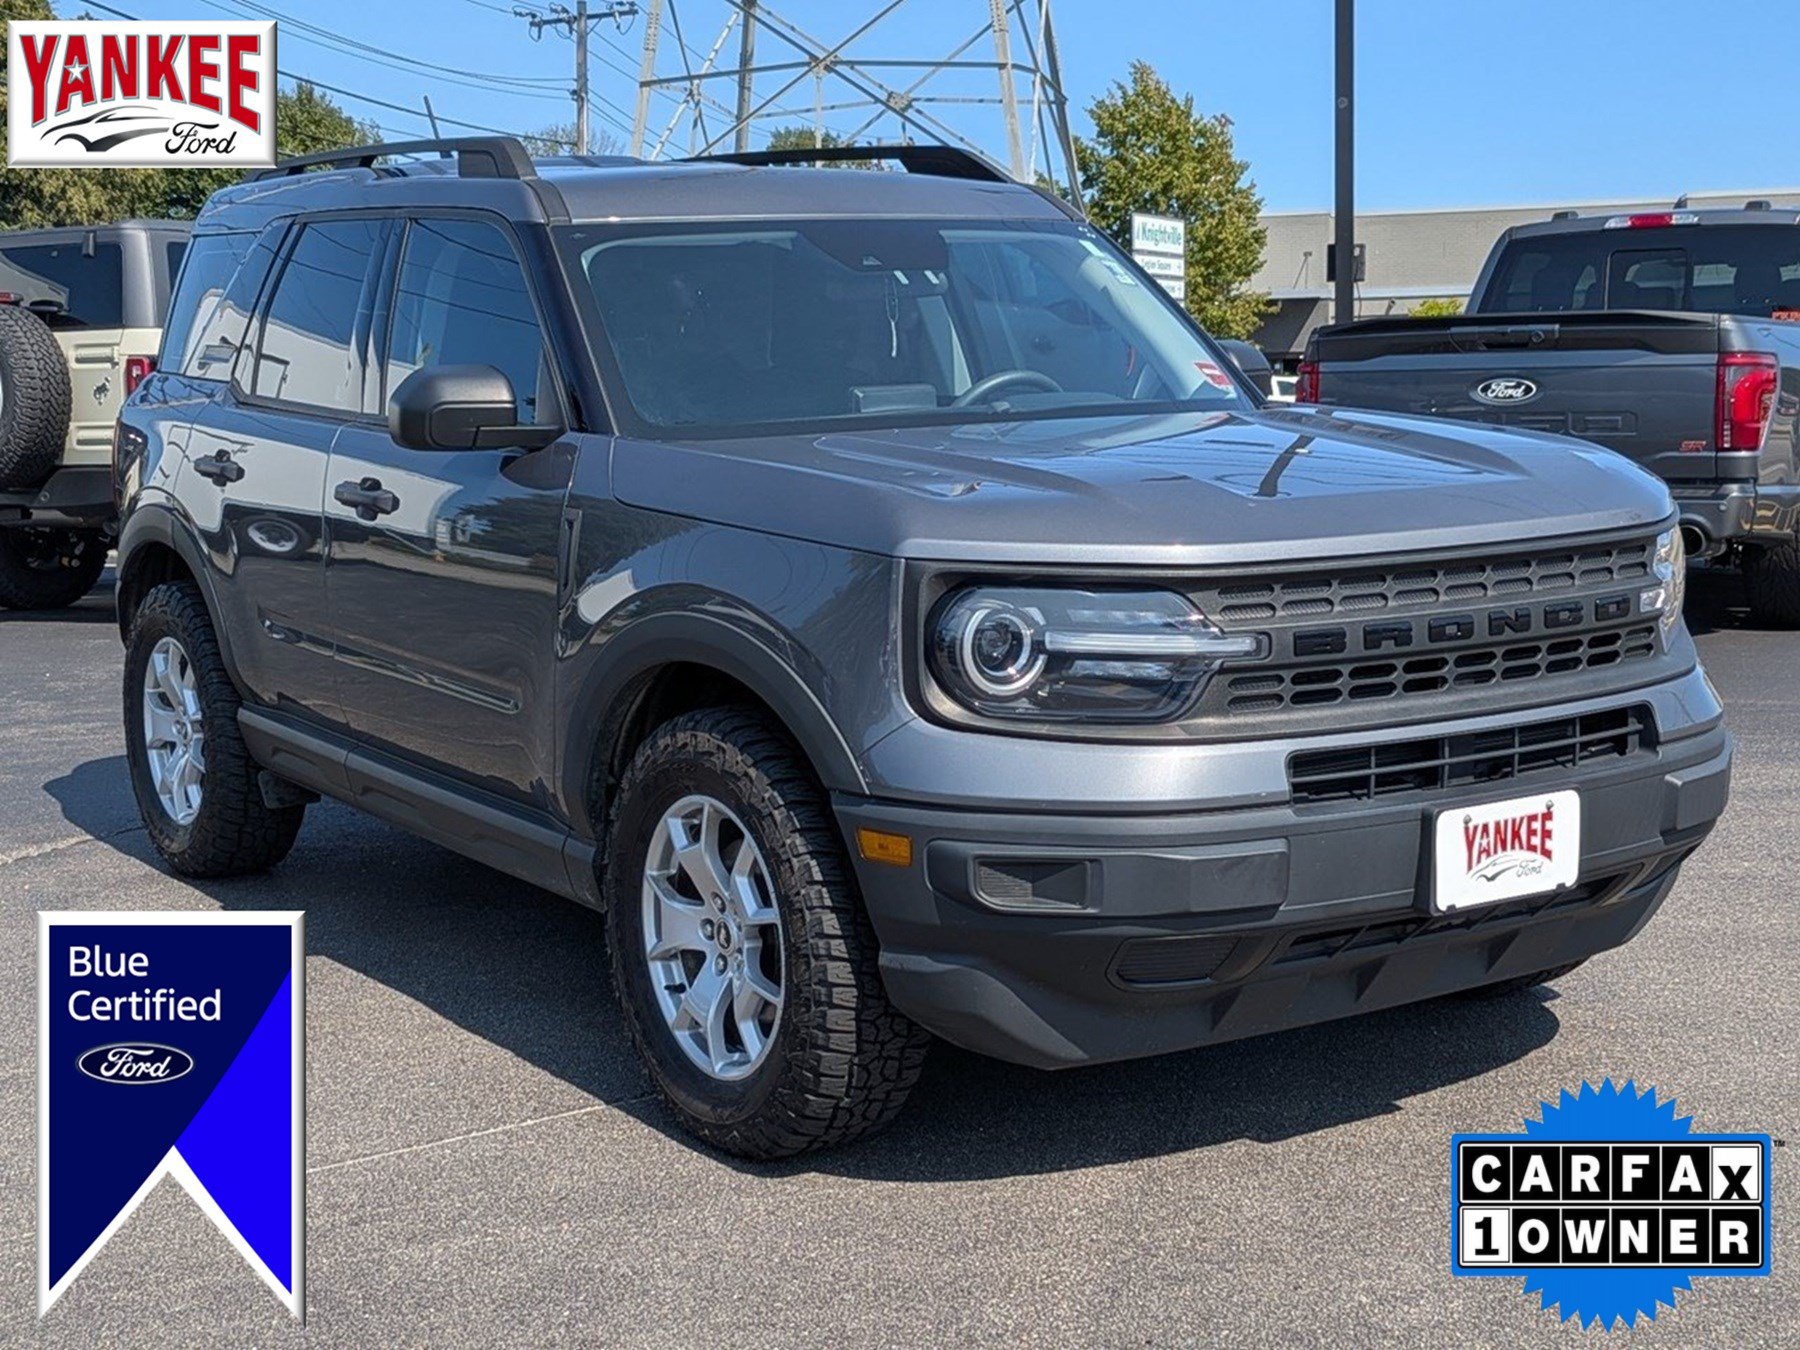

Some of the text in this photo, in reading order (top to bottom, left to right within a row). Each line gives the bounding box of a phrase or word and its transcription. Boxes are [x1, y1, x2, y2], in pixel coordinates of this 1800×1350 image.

[1141, 221, 1182, 246] Knightville
[1487, 381, 1526, 398] Ford
[1293, 595, 1631, 657] BRONCO
[1463, 809, 1554, 875] YANKEE
[1516, 858, 1544, 878] Ford
